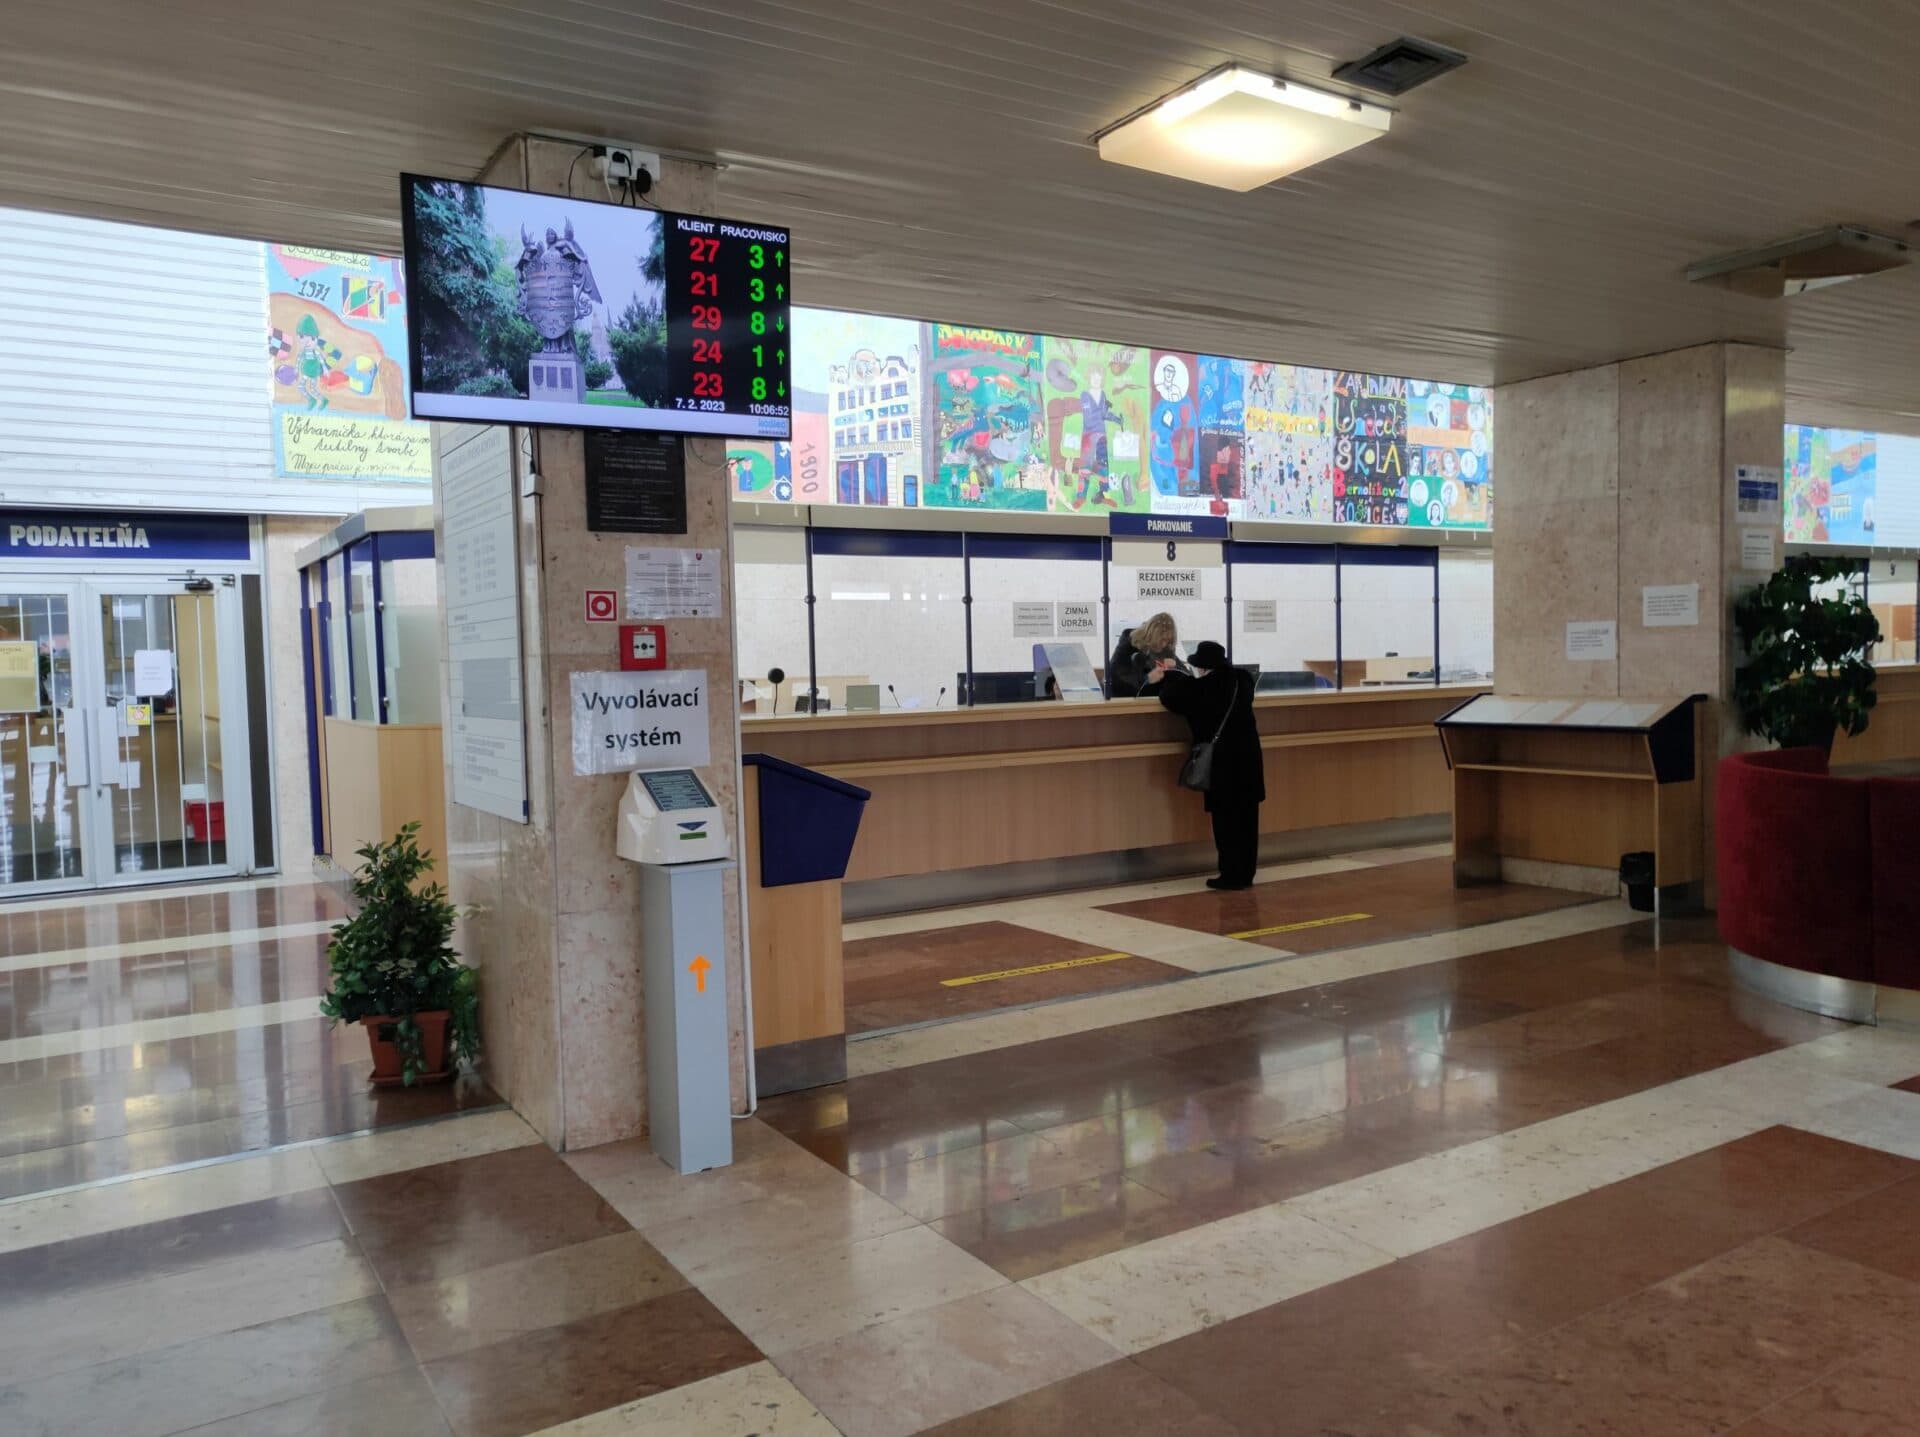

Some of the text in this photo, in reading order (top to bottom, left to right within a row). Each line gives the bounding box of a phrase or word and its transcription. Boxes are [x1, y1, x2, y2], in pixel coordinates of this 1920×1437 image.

[676, 219, 787, 243] KLIENT PRACOVISKO
[689, 236, 765, 269] 27 3
[297, 279, 331, 301] 1971
[690, 271, 765, 302] 21 3
[692, 304, 766, 335] 29 8
[692, 338, 764, 368] 24 1
[693, 371, 767, 400] 23 8
[700, 400, 725, 412] 2023
[748, 404, 789, 416] 10:06:52
[800, 441, 818, 493] 1900
[9, 522, 151, 549] PODATEĽŇA
[1147, 519, 1193, 533] PARKOVANIE
[1166, 540, 1177, 562] 8
[1138, 570, 1196, 582] REZIDENTSKÉ
[1140, 587, 1195, 597] PARKOVANIE
[1064, 605, 1090, 615] ZIMNÁ
[582, 687, 700, 715] Vyvolávací
[605, 727, 682, 753] systém
